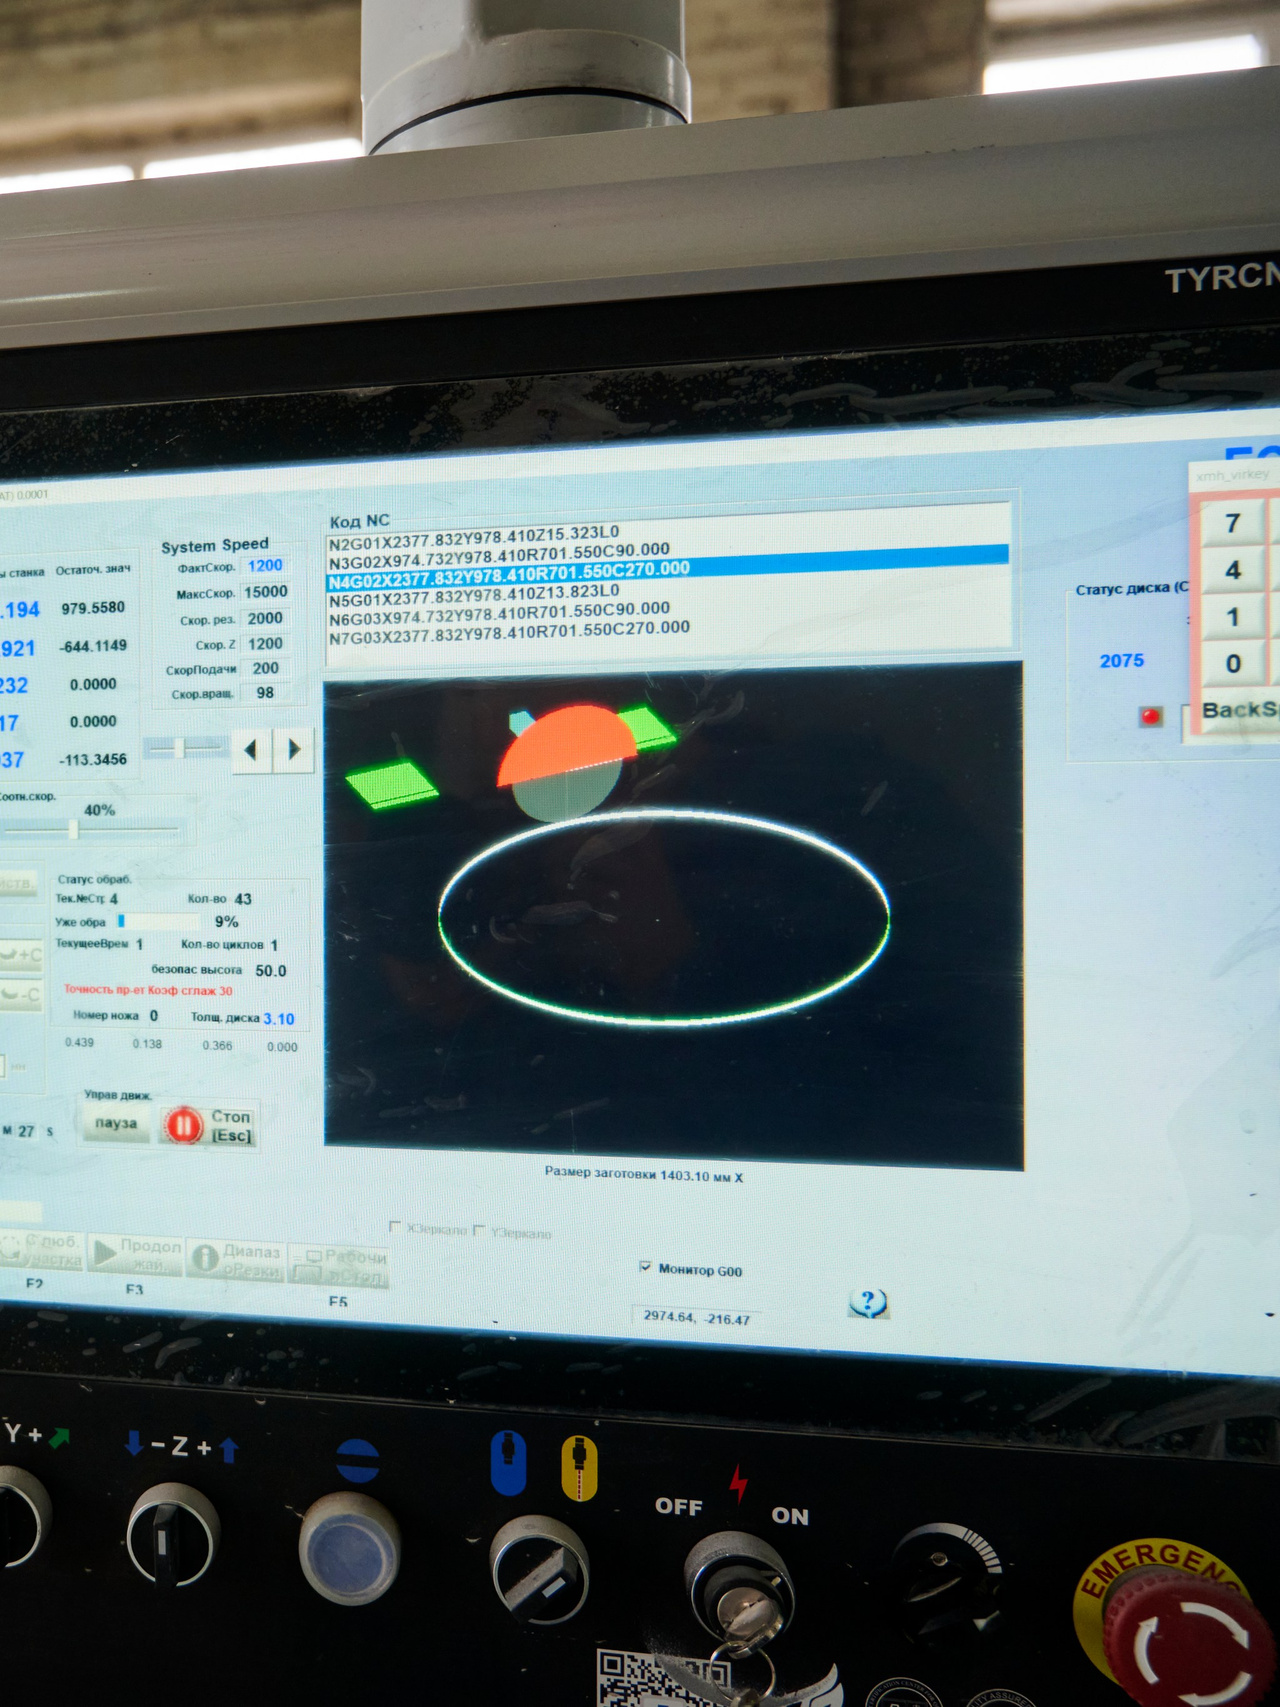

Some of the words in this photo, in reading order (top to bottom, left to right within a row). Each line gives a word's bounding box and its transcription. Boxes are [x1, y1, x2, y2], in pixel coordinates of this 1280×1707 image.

[17, 490, 48, 500] 0.0001
[330, 516, 361, 529] Код
[367, 513, 390, 527] NC
[1225, 513, 1241, 533] 7
[329, 525, 620, 552] N2G01X2377.832Y978.410Z15.323L0
[161, 540, 216, 555] System
[222, 537, 269, 552] Speed
[329, 542, 670, 571] N3G02X974.732Y978.410R701.550C90.000
[55, 565, 103, 576] Остаточ.
[105, 563, 130, 574] знач
[178, 561, 236, 575] ФактСкор.
[248, 559, 283, 572] 1200
[1225, 561, 1241, 579] 4
[9, 567, 45, 578] станка
[329, 561, 690, 590] N4G02X2377.832Y978.410R701.550C270.000
[177, 587, 236, 600] МаксСкор.
[245, 584, 288, 598] 15000
[1076, 585, 1123, 596] Статус
[1126, 582, 1170, 595] диска
[329, 584, 620, 608] N5G01X2377.832Y978.410Z13.823L0
[62, 601, 125, 615] 979.5580
[329, 601, 670, 627] N6G03X974.732Y978.410R701.550C90.000
[181, 615, 211, 627] Скор.
[213, 616, 236, 626] рез.
[248, 611, 283, 625] 2000
[1227, 607, 1238, 626] 1
[329, 620, 690, 646] N7G03X2377.832Y978.410R701.550C270.000
[59, 639, 127, 653] -644.1149
[196, 640, 227, 651] Скор.
[229, 639, 235, 650] Z
[248, 637, 283, 650] 1200
[1100, 653, 1144, 668] 2075
[1226, 654, 1241, 673] 0
[166, 665, 236, 676] СкорПодачи
[253, 662, 279, 674] 200
[70, 678, 117, 691] 0.0000
[172, 689, 234, 700] Скор.вращ.
[257, 686, 274, 699] 98
[1203, 701, 1280, 718] BackS
[70, 715, 117, 727] 0.0000
[59, 754, 127, 766] -113.3456
[84, 804, 115, 816] 40%
[58, 874, 94, 887] Статус
[96, 875, 132, 886] обраб.
[110, 893, 118, 904] 4
[188, 894, 227, 904] Кол-во
[235, 893, 252, 906] 43
[55, 917, 77, 928] Уже
[215, 915, 239, 928] 9%
[137, 938, 143, 950] 1
[182, 939, 220, 949] Кол-во
[222, 940, 264, 951] циклов
[271, 940, 278, 951] 1
[152, 964, 197, 975] безопас
[200, 965, 242, 975] высота
[255, 964, 287, 977] 50.0
[64, 984, 114, 995] Точность
[116, 985, 145, 995] пр-ет
[147, 985, 177, 996] Коэф
[181, 986, 217, 996] сглаж
[220, 986, 233, 997] 30
[73, 1010, 108, 1022] Номер
[111, 1011, 139, 1021] ножа
[150, 1010, 158, 1022] 0
[191, 1012, 223, 1023] Толщ.
[225, 1013, 260, 1024] диска
[263, 1012, 295, 1026] 3.10
[65, 1037, 94, 1048] 0.439
[133, 1039, 162, 1050] 0.138
[202, 1040, 232, 1051] 0.366
[267, 1042, 298, 1052] 0.000
[84, 1089, 117, 1100] Управ
[120, 1092, 152, 1101] движ.
[212, 1110, 250, 1123] Стоп
[96, 1118, 137, 1130] пауза
[18, 1125, 34, 1137] 27
[212, 1128, 251, 1143] [Esc]
[545, 1166, 591, 1177] Размер
[595, 1169, 656, 1180] заготовки
[660, 1171, 709, 1181] 1403.10
[713, 1174, 731, 1182] мм
[734, 1173, 743, 1183] X
[121, 1238, 181, 1255] Продол
[223, 1244, 281, 1259] Диапаз
[659, 1263, 714, 1277] Монитор
[718, 1267, 742, 1277] G00
[644, 1310, 697, 1324] 2974.64,
[704, 1314, 750, 1325] -216.47
[655, 1497, 703, 1516] OFF
[772, 1506, 809, 1526] ON
